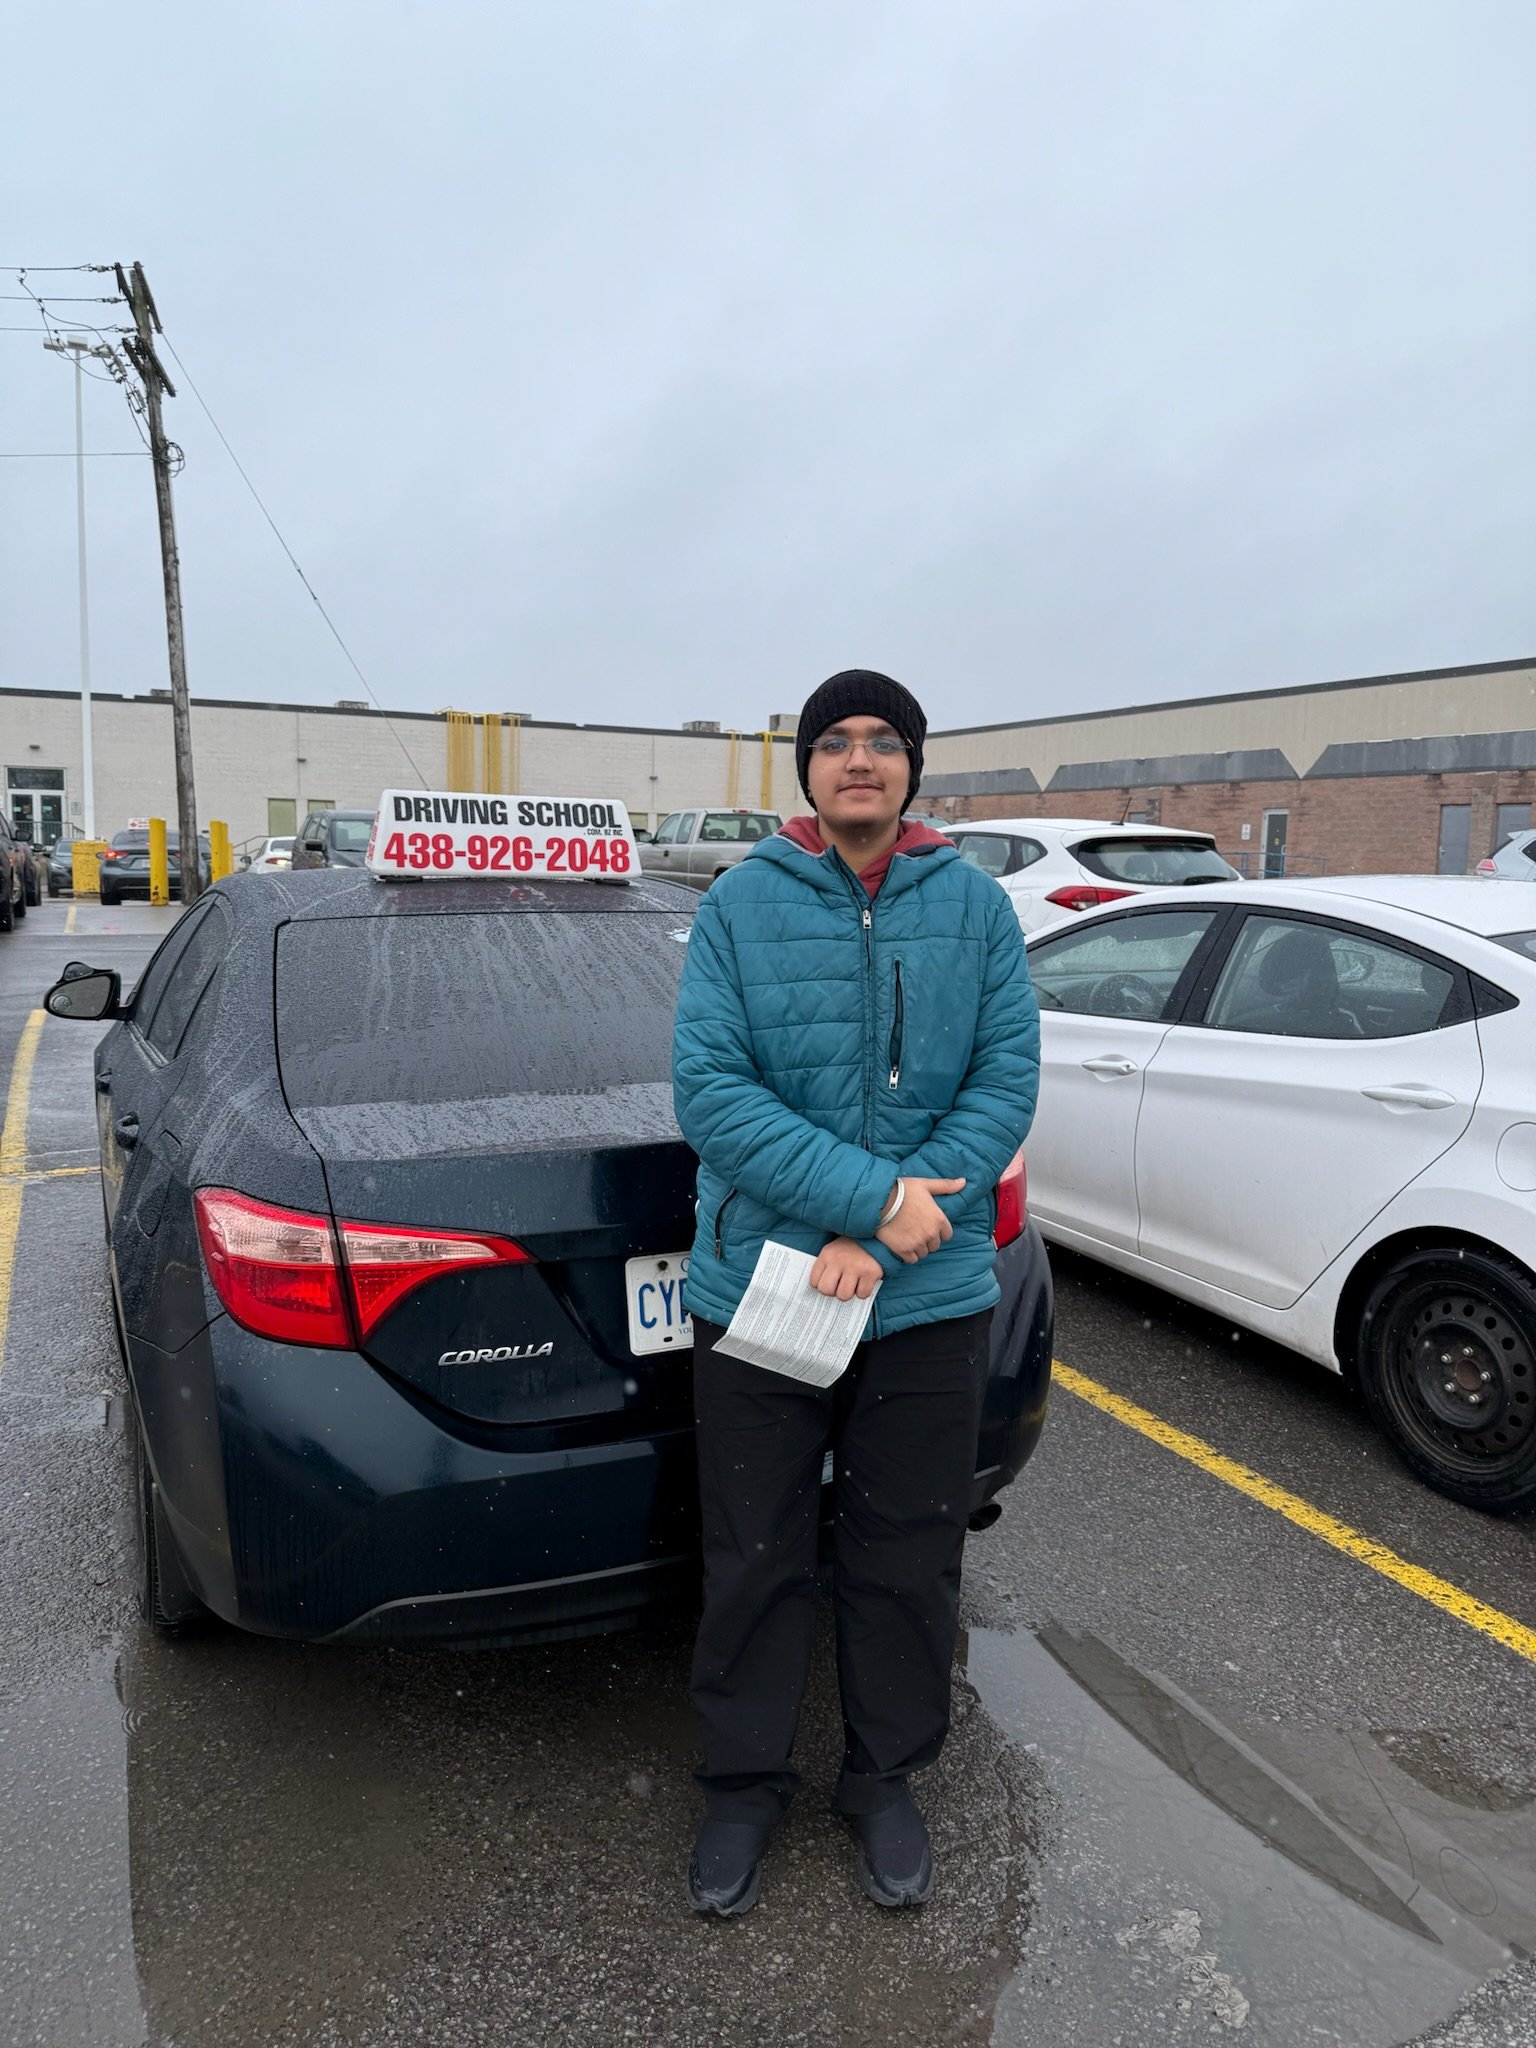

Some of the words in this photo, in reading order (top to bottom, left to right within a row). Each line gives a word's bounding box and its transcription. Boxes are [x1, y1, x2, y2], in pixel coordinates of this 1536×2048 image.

[393, 796, 509, 825] DRIVING
[518, 801, 622, 829] SCHOOL
[384, 832, 630, 873] 438-926-2048
[438, 1342, 553, 1367] COROLLA
